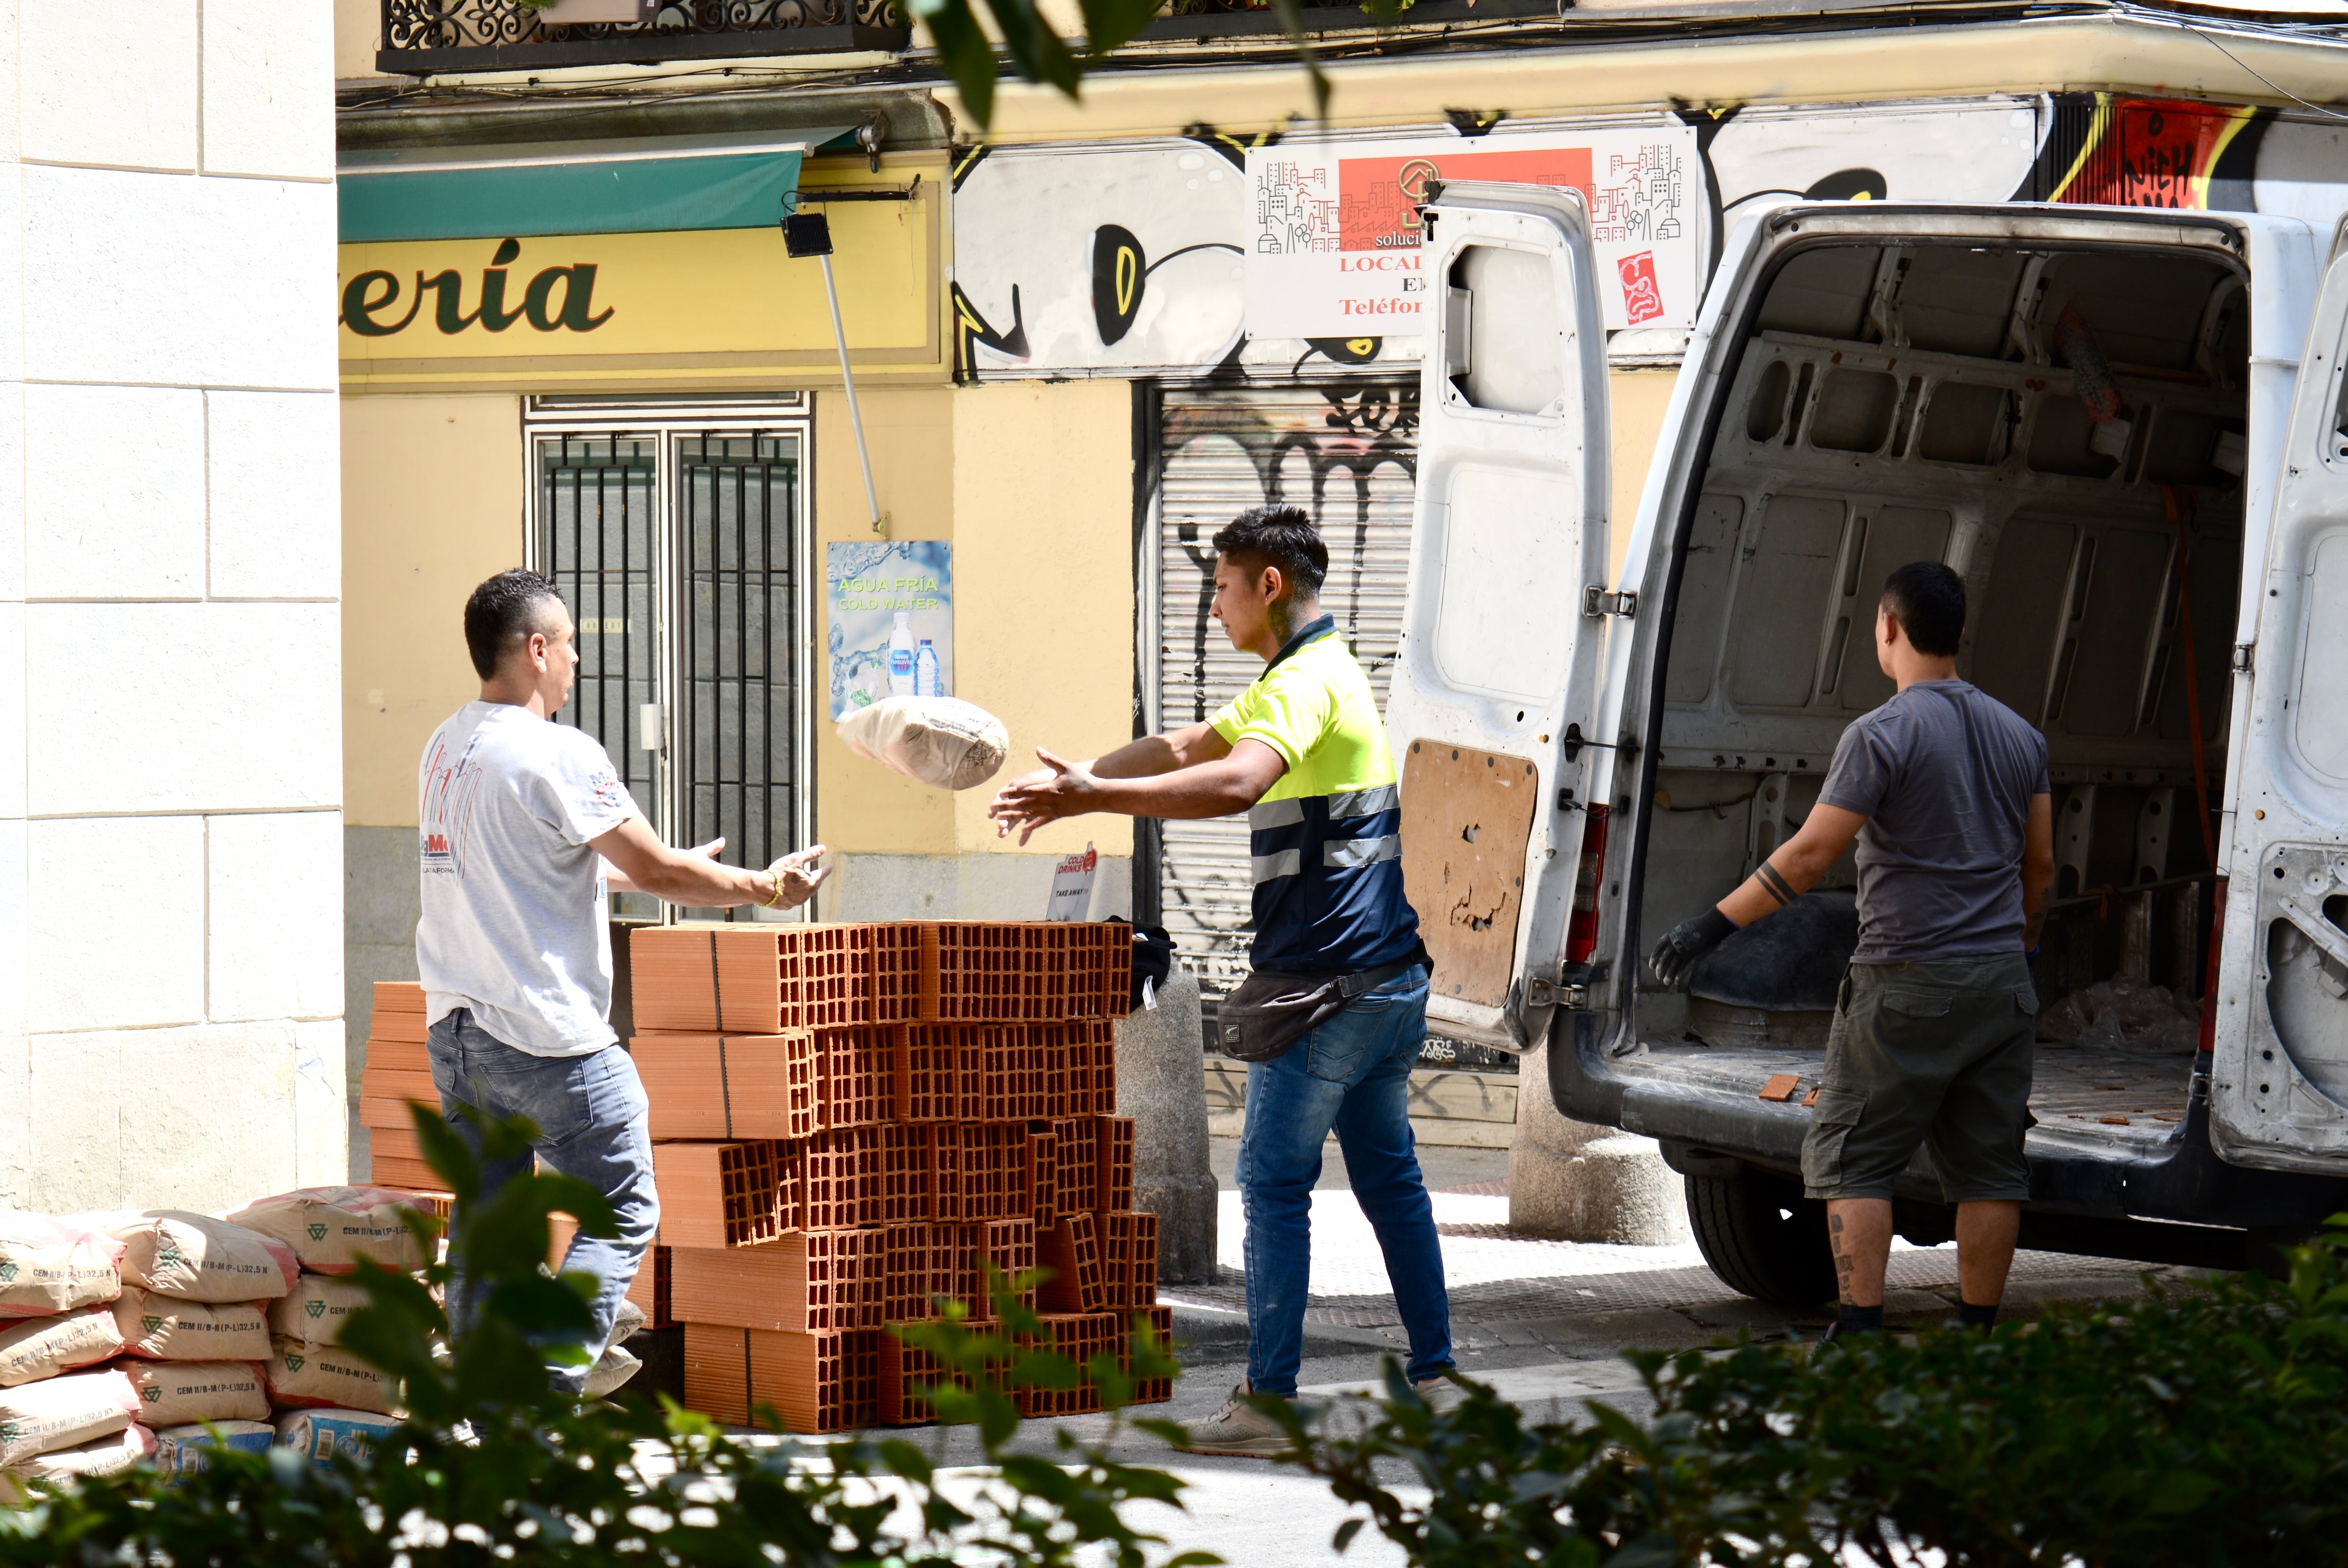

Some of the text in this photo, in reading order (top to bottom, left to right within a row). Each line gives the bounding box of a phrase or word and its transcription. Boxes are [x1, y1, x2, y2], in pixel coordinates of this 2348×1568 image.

[1376, 230, 1421, 247] soluci
[339, 237, 616, 337] ería
[1402, 278, 1422, 292] E
[838, 575, 939, 592] AGUA FRÍA
[839, 598, 939, 610] COLD WATER
[1058, 864, 1082, 874] DRINKS
[178, 1321, 195, 1330] CEM
[11, 1355, 29, 1367] CEM
[320, 1363, 336, 1372] CEM
[24, 1426, 40, 1435] CEM
[54, 1475, 71, 1485] CEM
